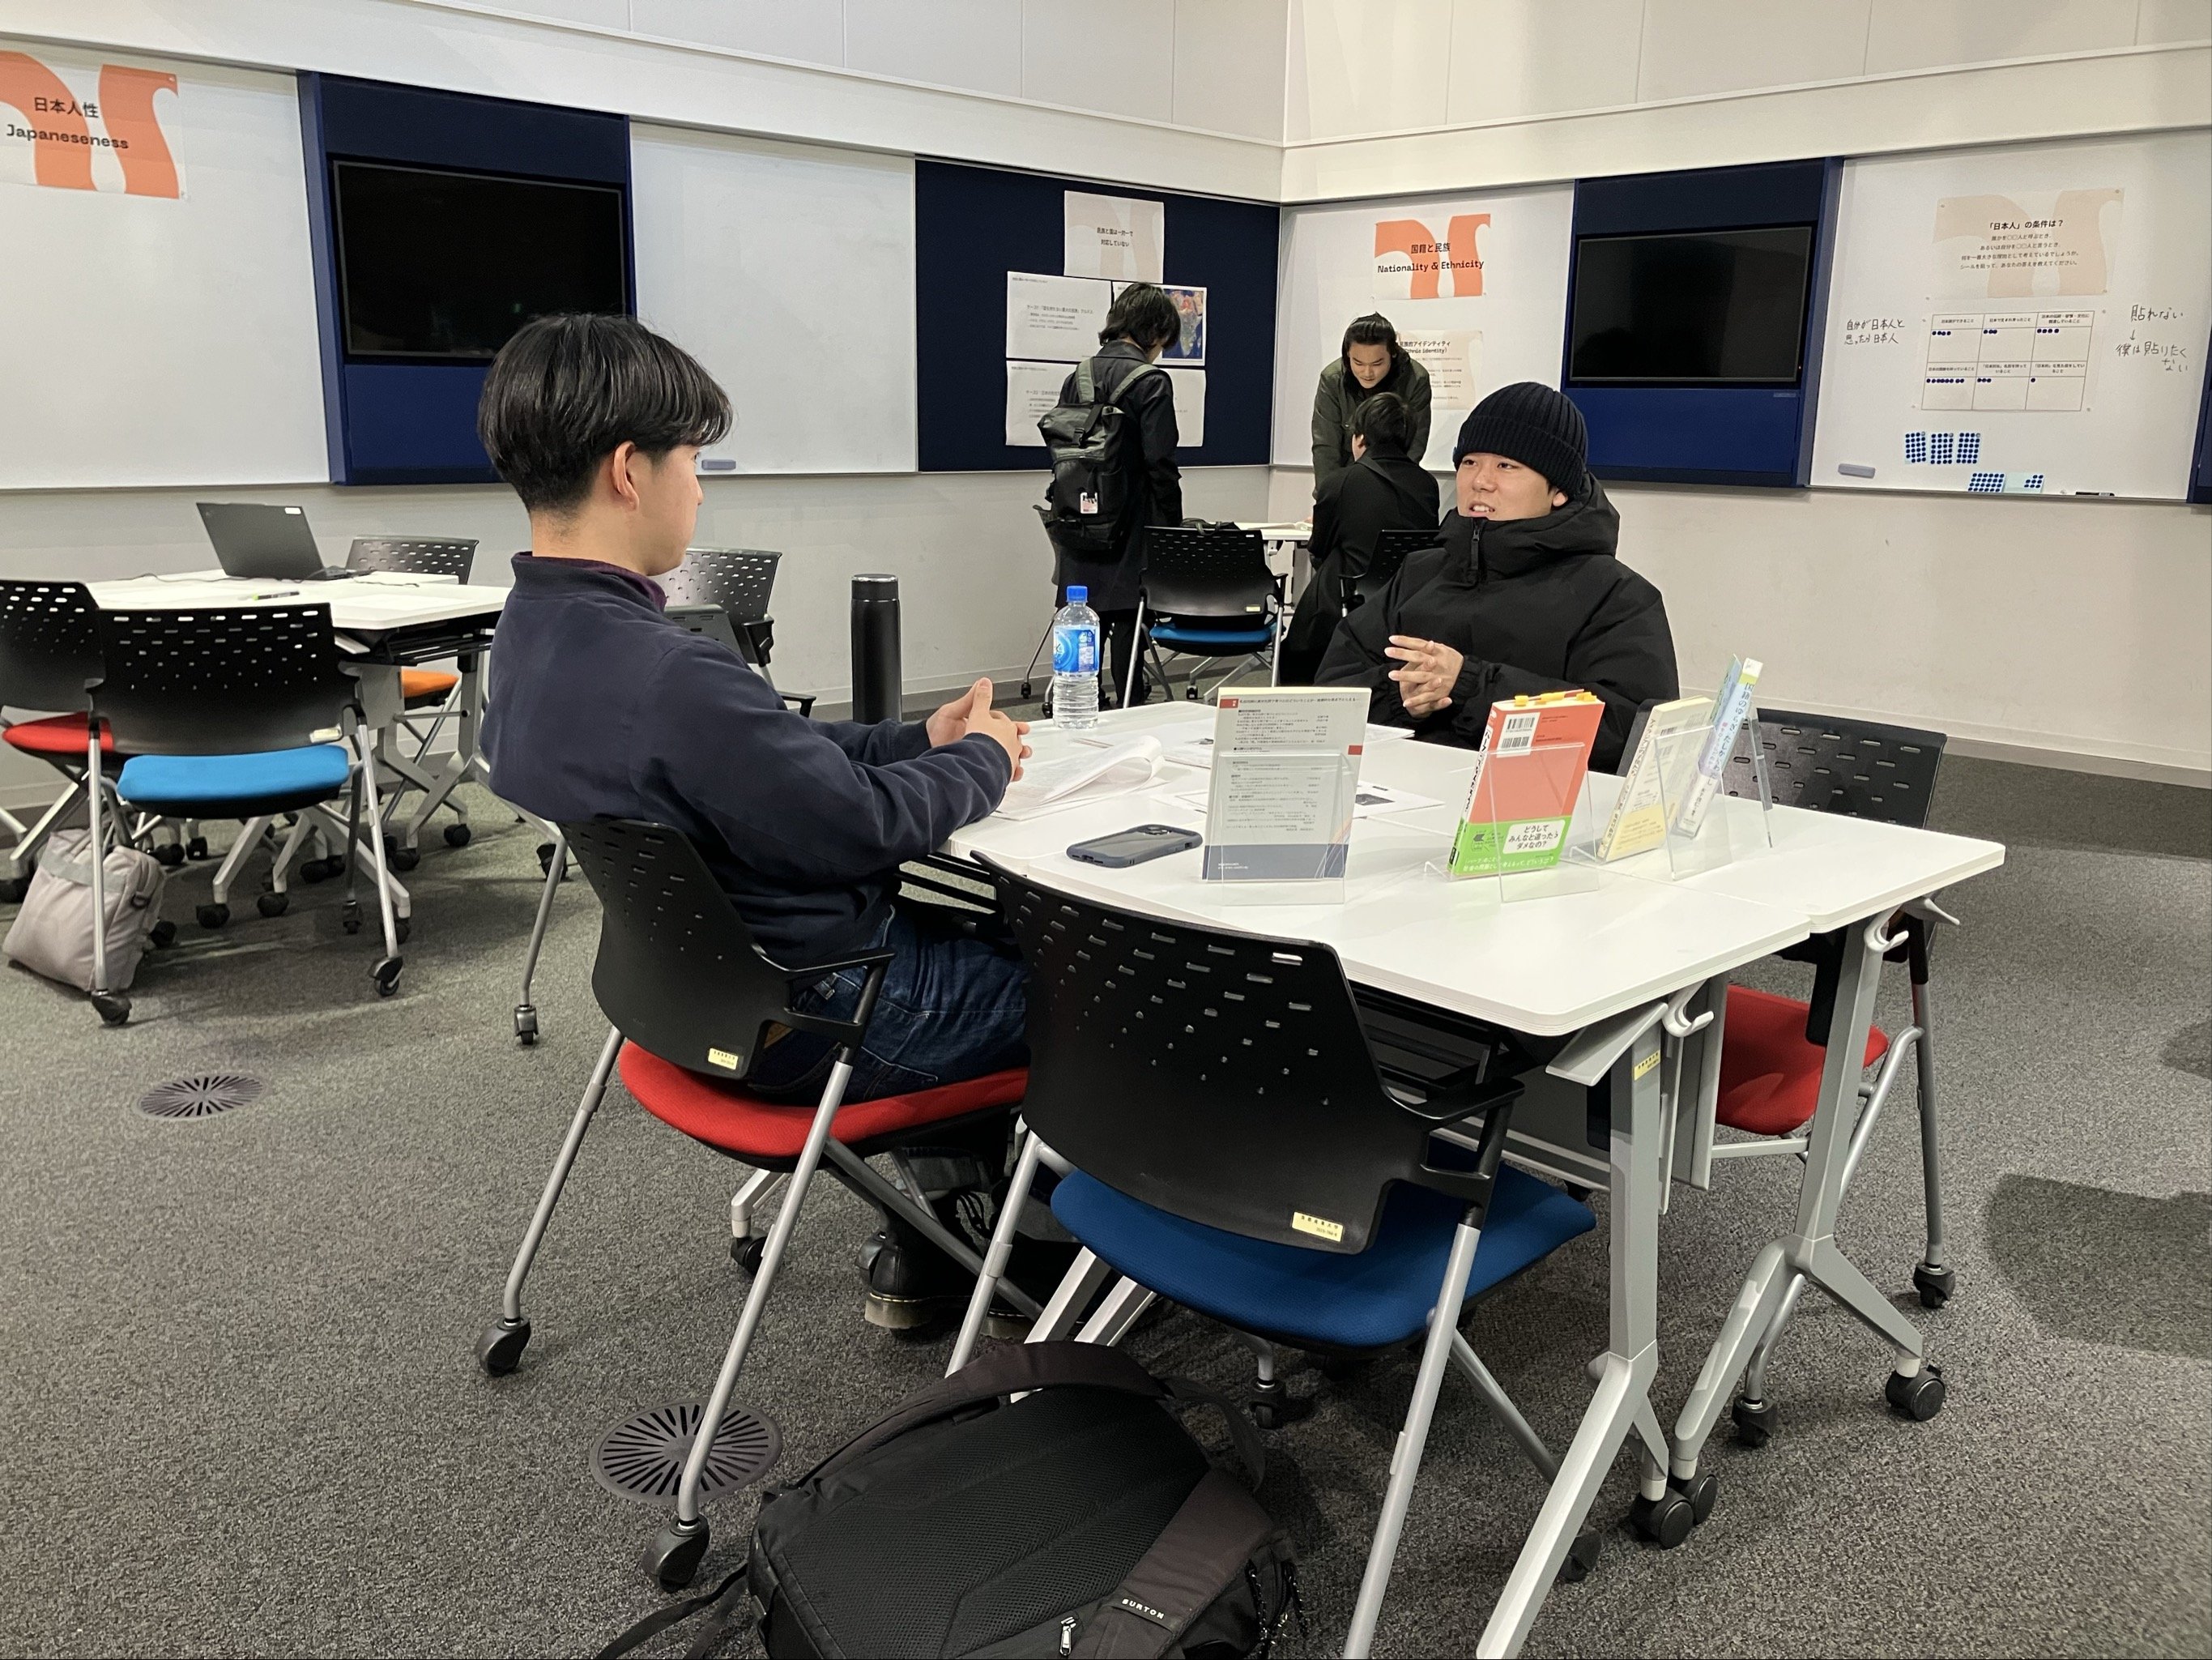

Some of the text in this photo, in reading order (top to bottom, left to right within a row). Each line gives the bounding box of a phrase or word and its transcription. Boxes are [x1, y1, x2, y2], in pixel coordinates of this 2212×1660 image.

[34, 96, 99, 118] 日本人性
[6, 124, 129, 149] Japaneseness
[1411, 243, 1451, 254] 国籍と民族
[1378, 263, 1428, 272] Nationality
[1442, 260, 1484, 269] Ethnicity
[2131, 305, 2183, 322] 貼れない
[1524, 825, 1549, 833] どうして
[1508, 833, 1558, 843] みんなと違ったら
[1122, 1598, 1165, 1619] BURTON
